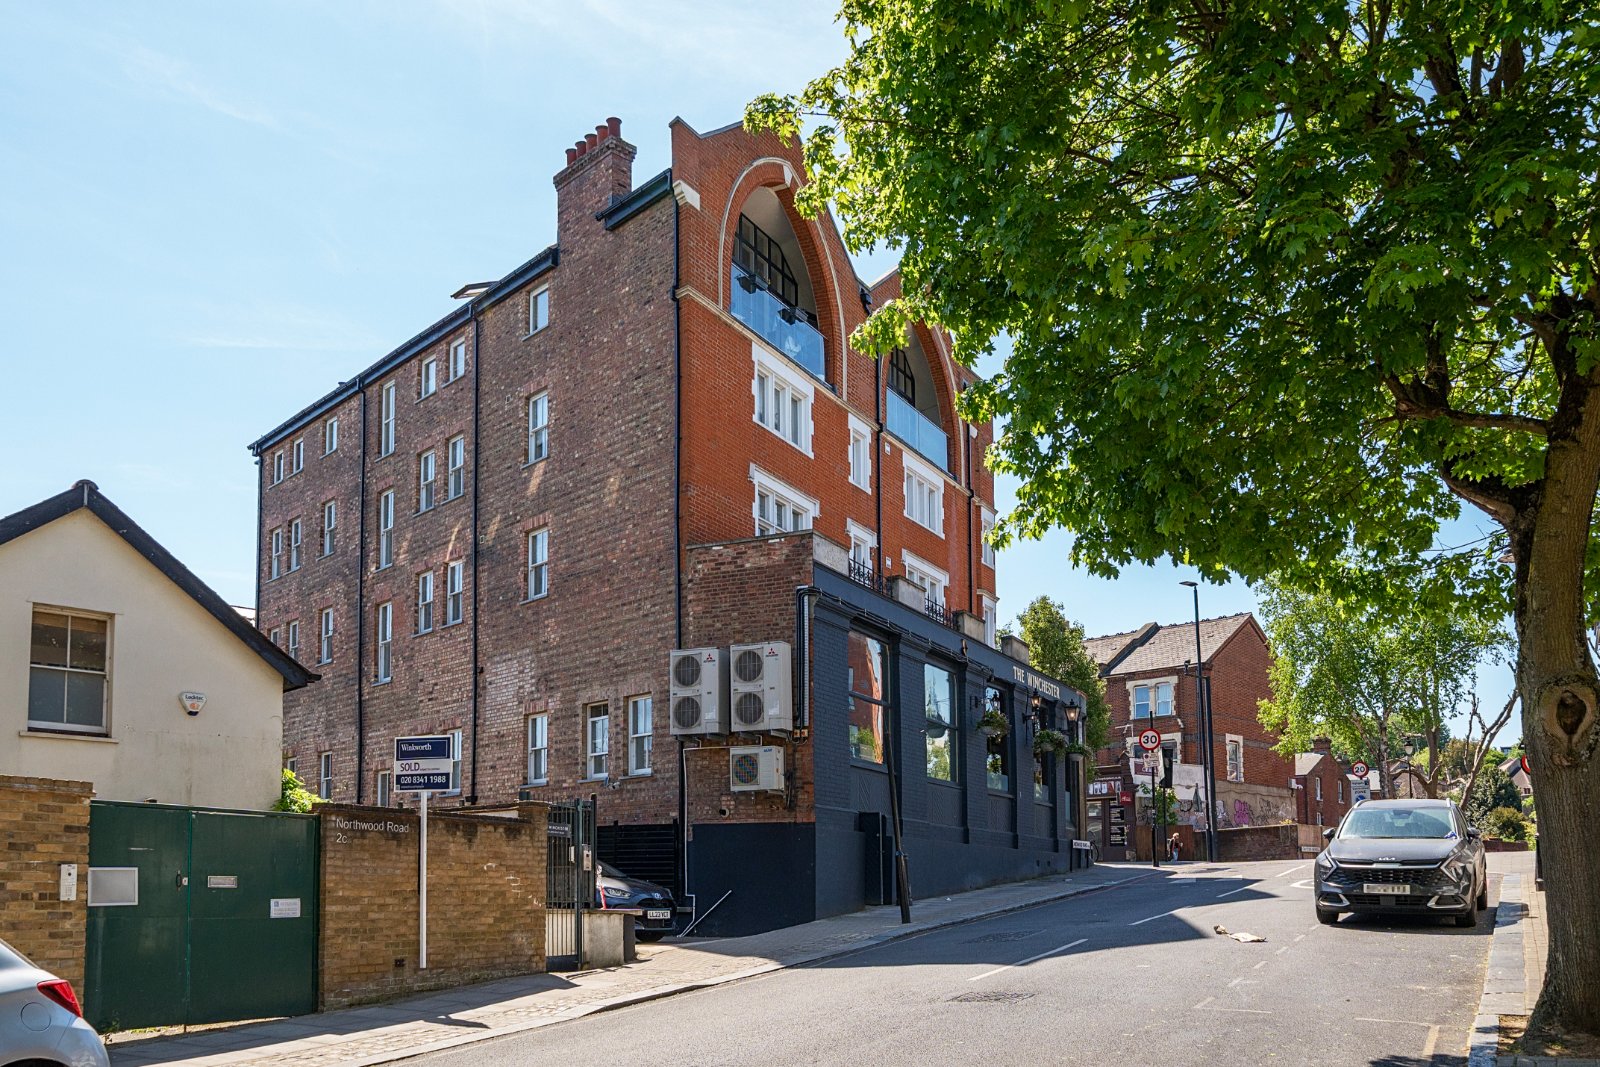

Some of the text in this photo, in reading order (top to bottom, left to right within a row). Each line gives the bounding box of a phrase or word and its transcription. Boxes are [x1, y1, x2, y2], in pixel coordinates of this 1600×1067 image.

[1013, 666, 1060, 699] THE WINCHESTER
[1142, 735, 1157, 744] 30
[401, 743, 432, 751] Winkworth
[400, 762, 420, 772] SOLD
[412, 776, 428, 784] 8341
[430, 775, 446, 783] 1988
[336, 818, 410, 833] Northwood Road
[336, 832, 348, 843] 2c
